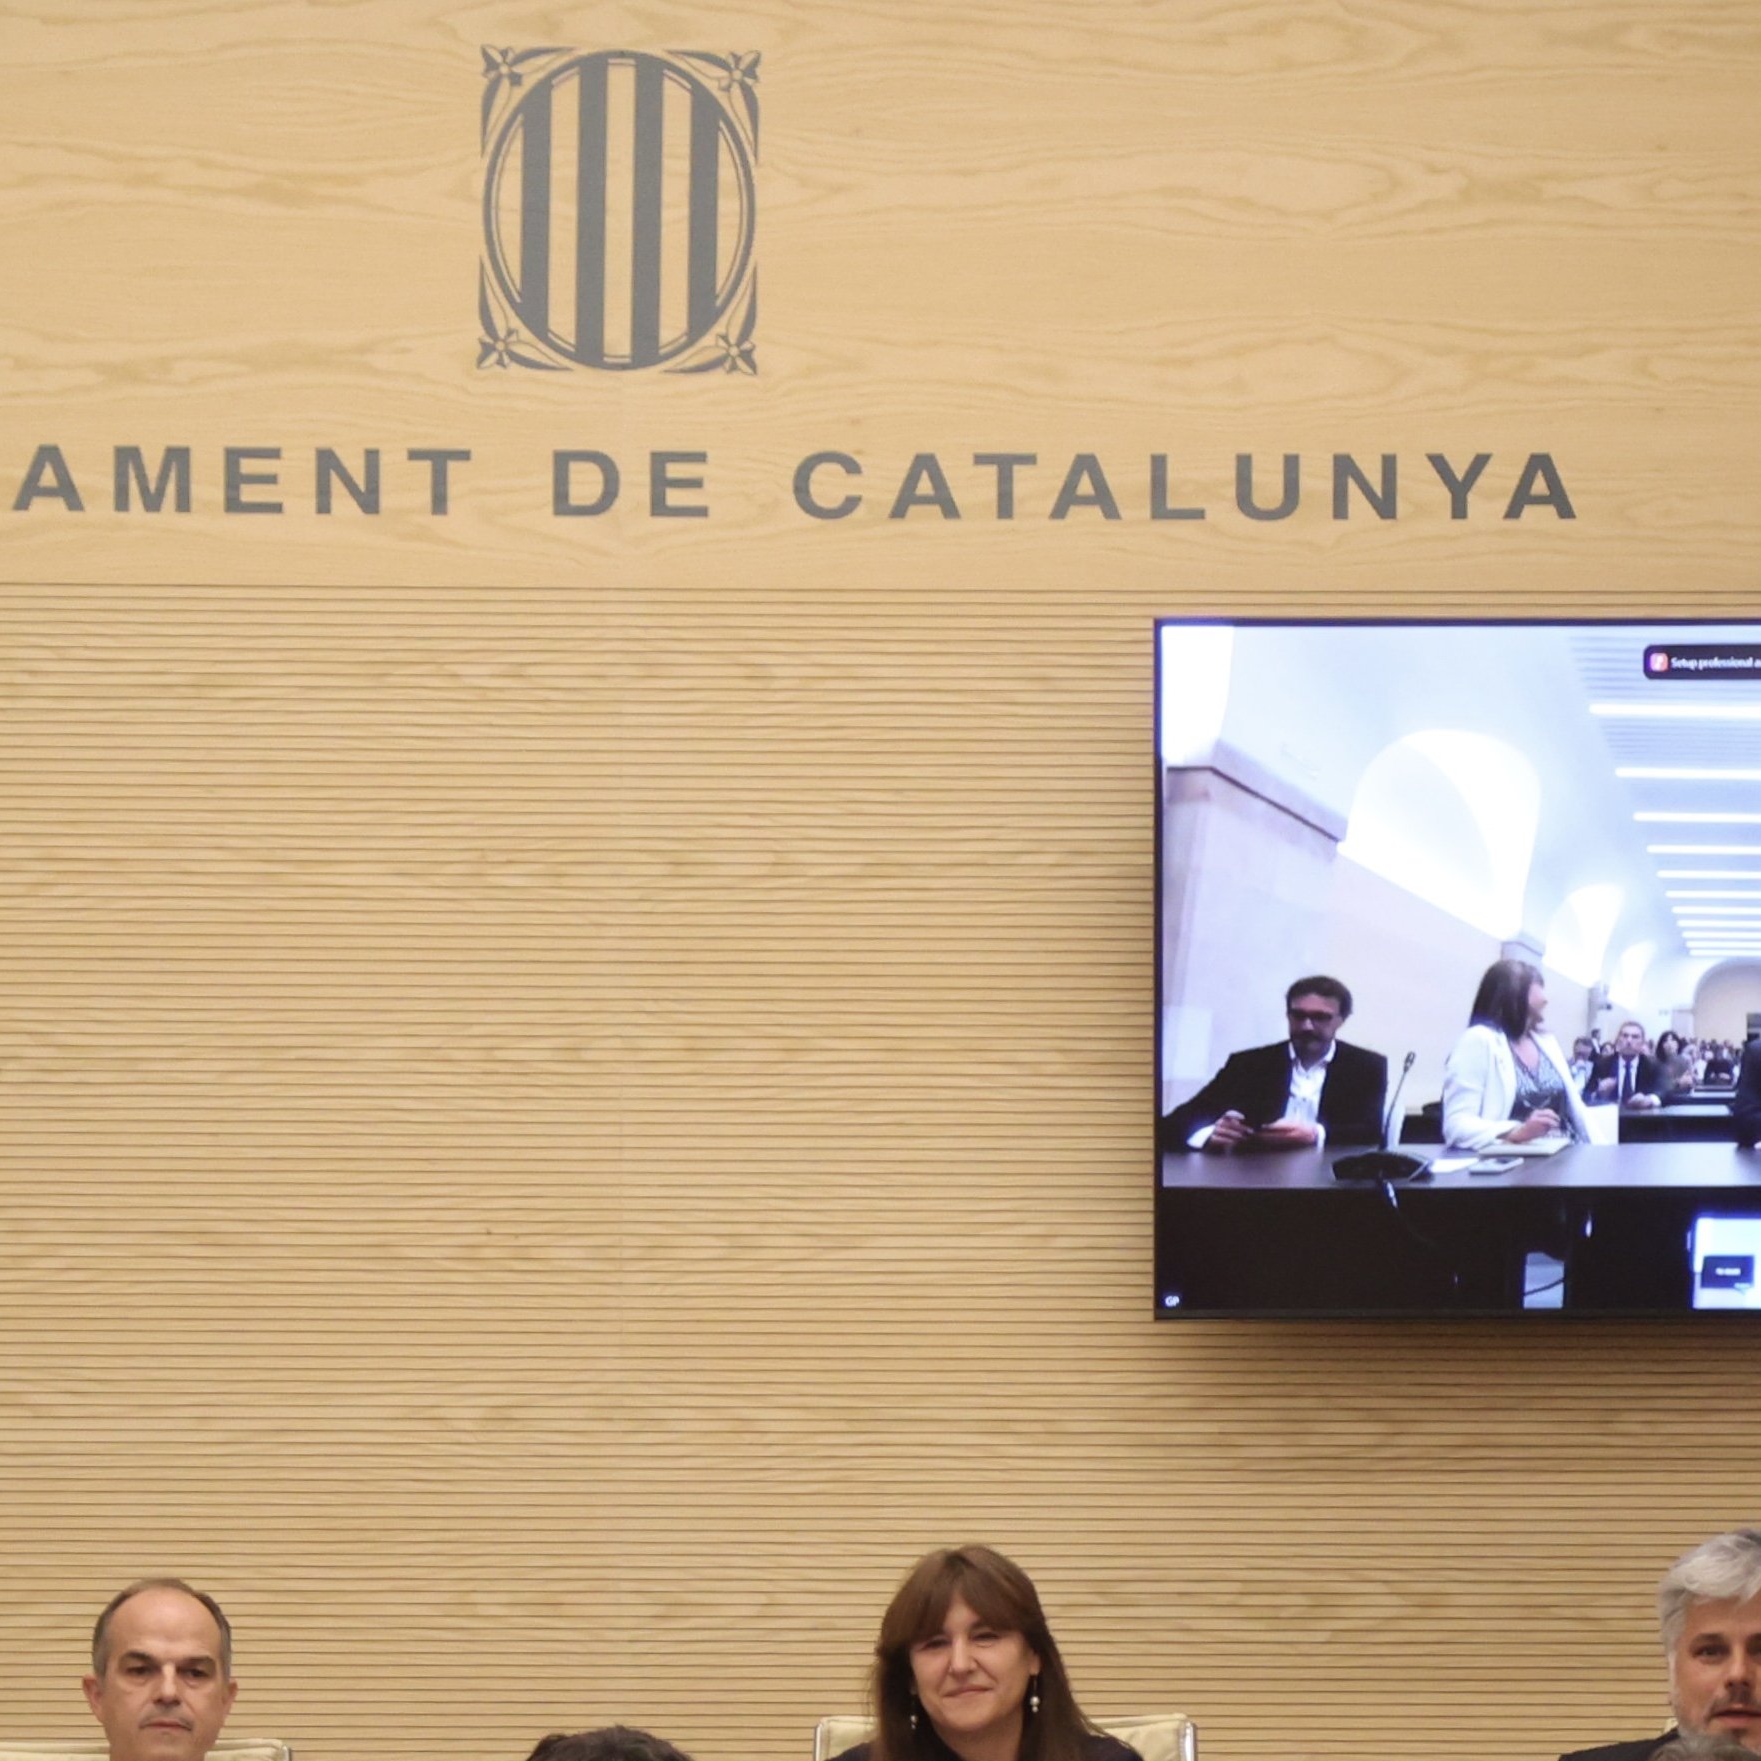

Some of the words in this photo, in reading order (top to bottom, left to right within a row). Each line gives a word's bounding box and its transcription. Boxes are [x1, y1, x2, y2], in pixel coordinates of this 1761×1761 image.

[552, 450, 710, 519] DE
[792, 451, 1579, 523] CATALUNYA
[1670, 656, 1697, 670] Setup
[1698, 655, 1753, 670] professional
